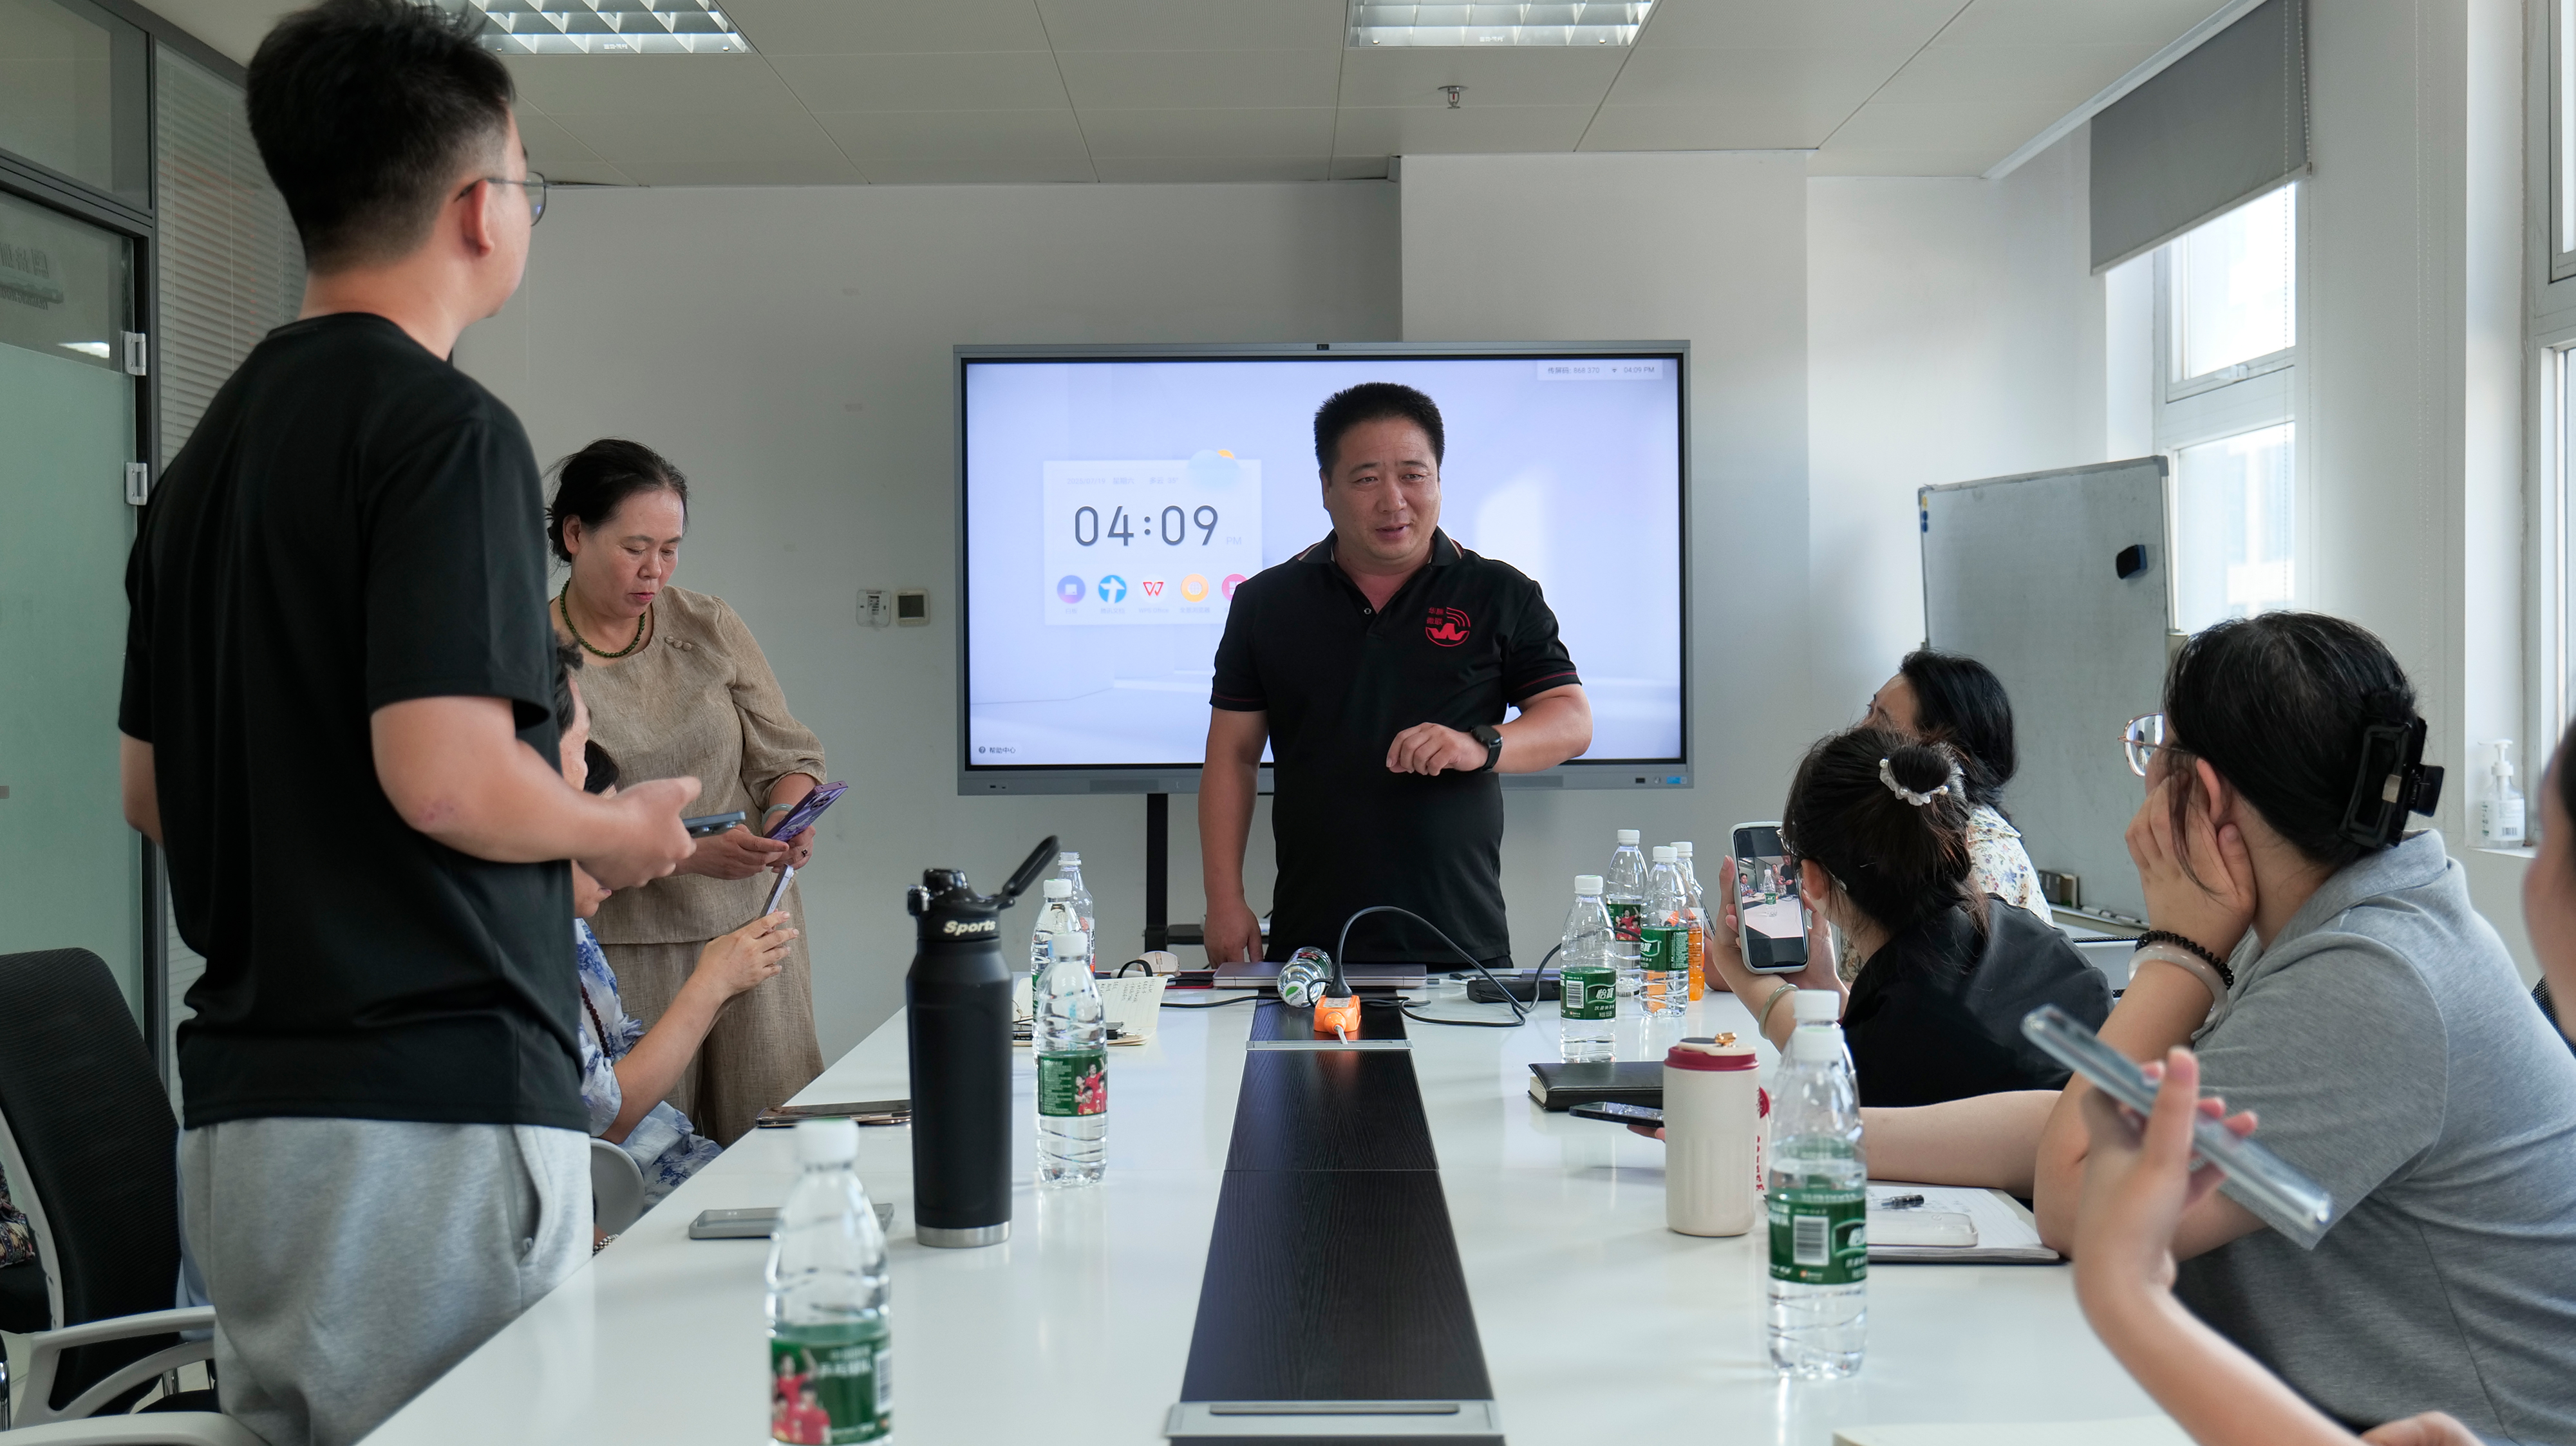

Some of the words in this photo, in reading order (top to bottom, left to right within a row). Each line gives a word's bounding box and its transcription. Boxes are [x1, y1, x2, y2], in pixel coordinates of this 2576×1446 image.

[1075, 505, 1218, 547] 04:09
[1226, 536, 1242, 545] PM
[943, 919, 996, 937] Sports
